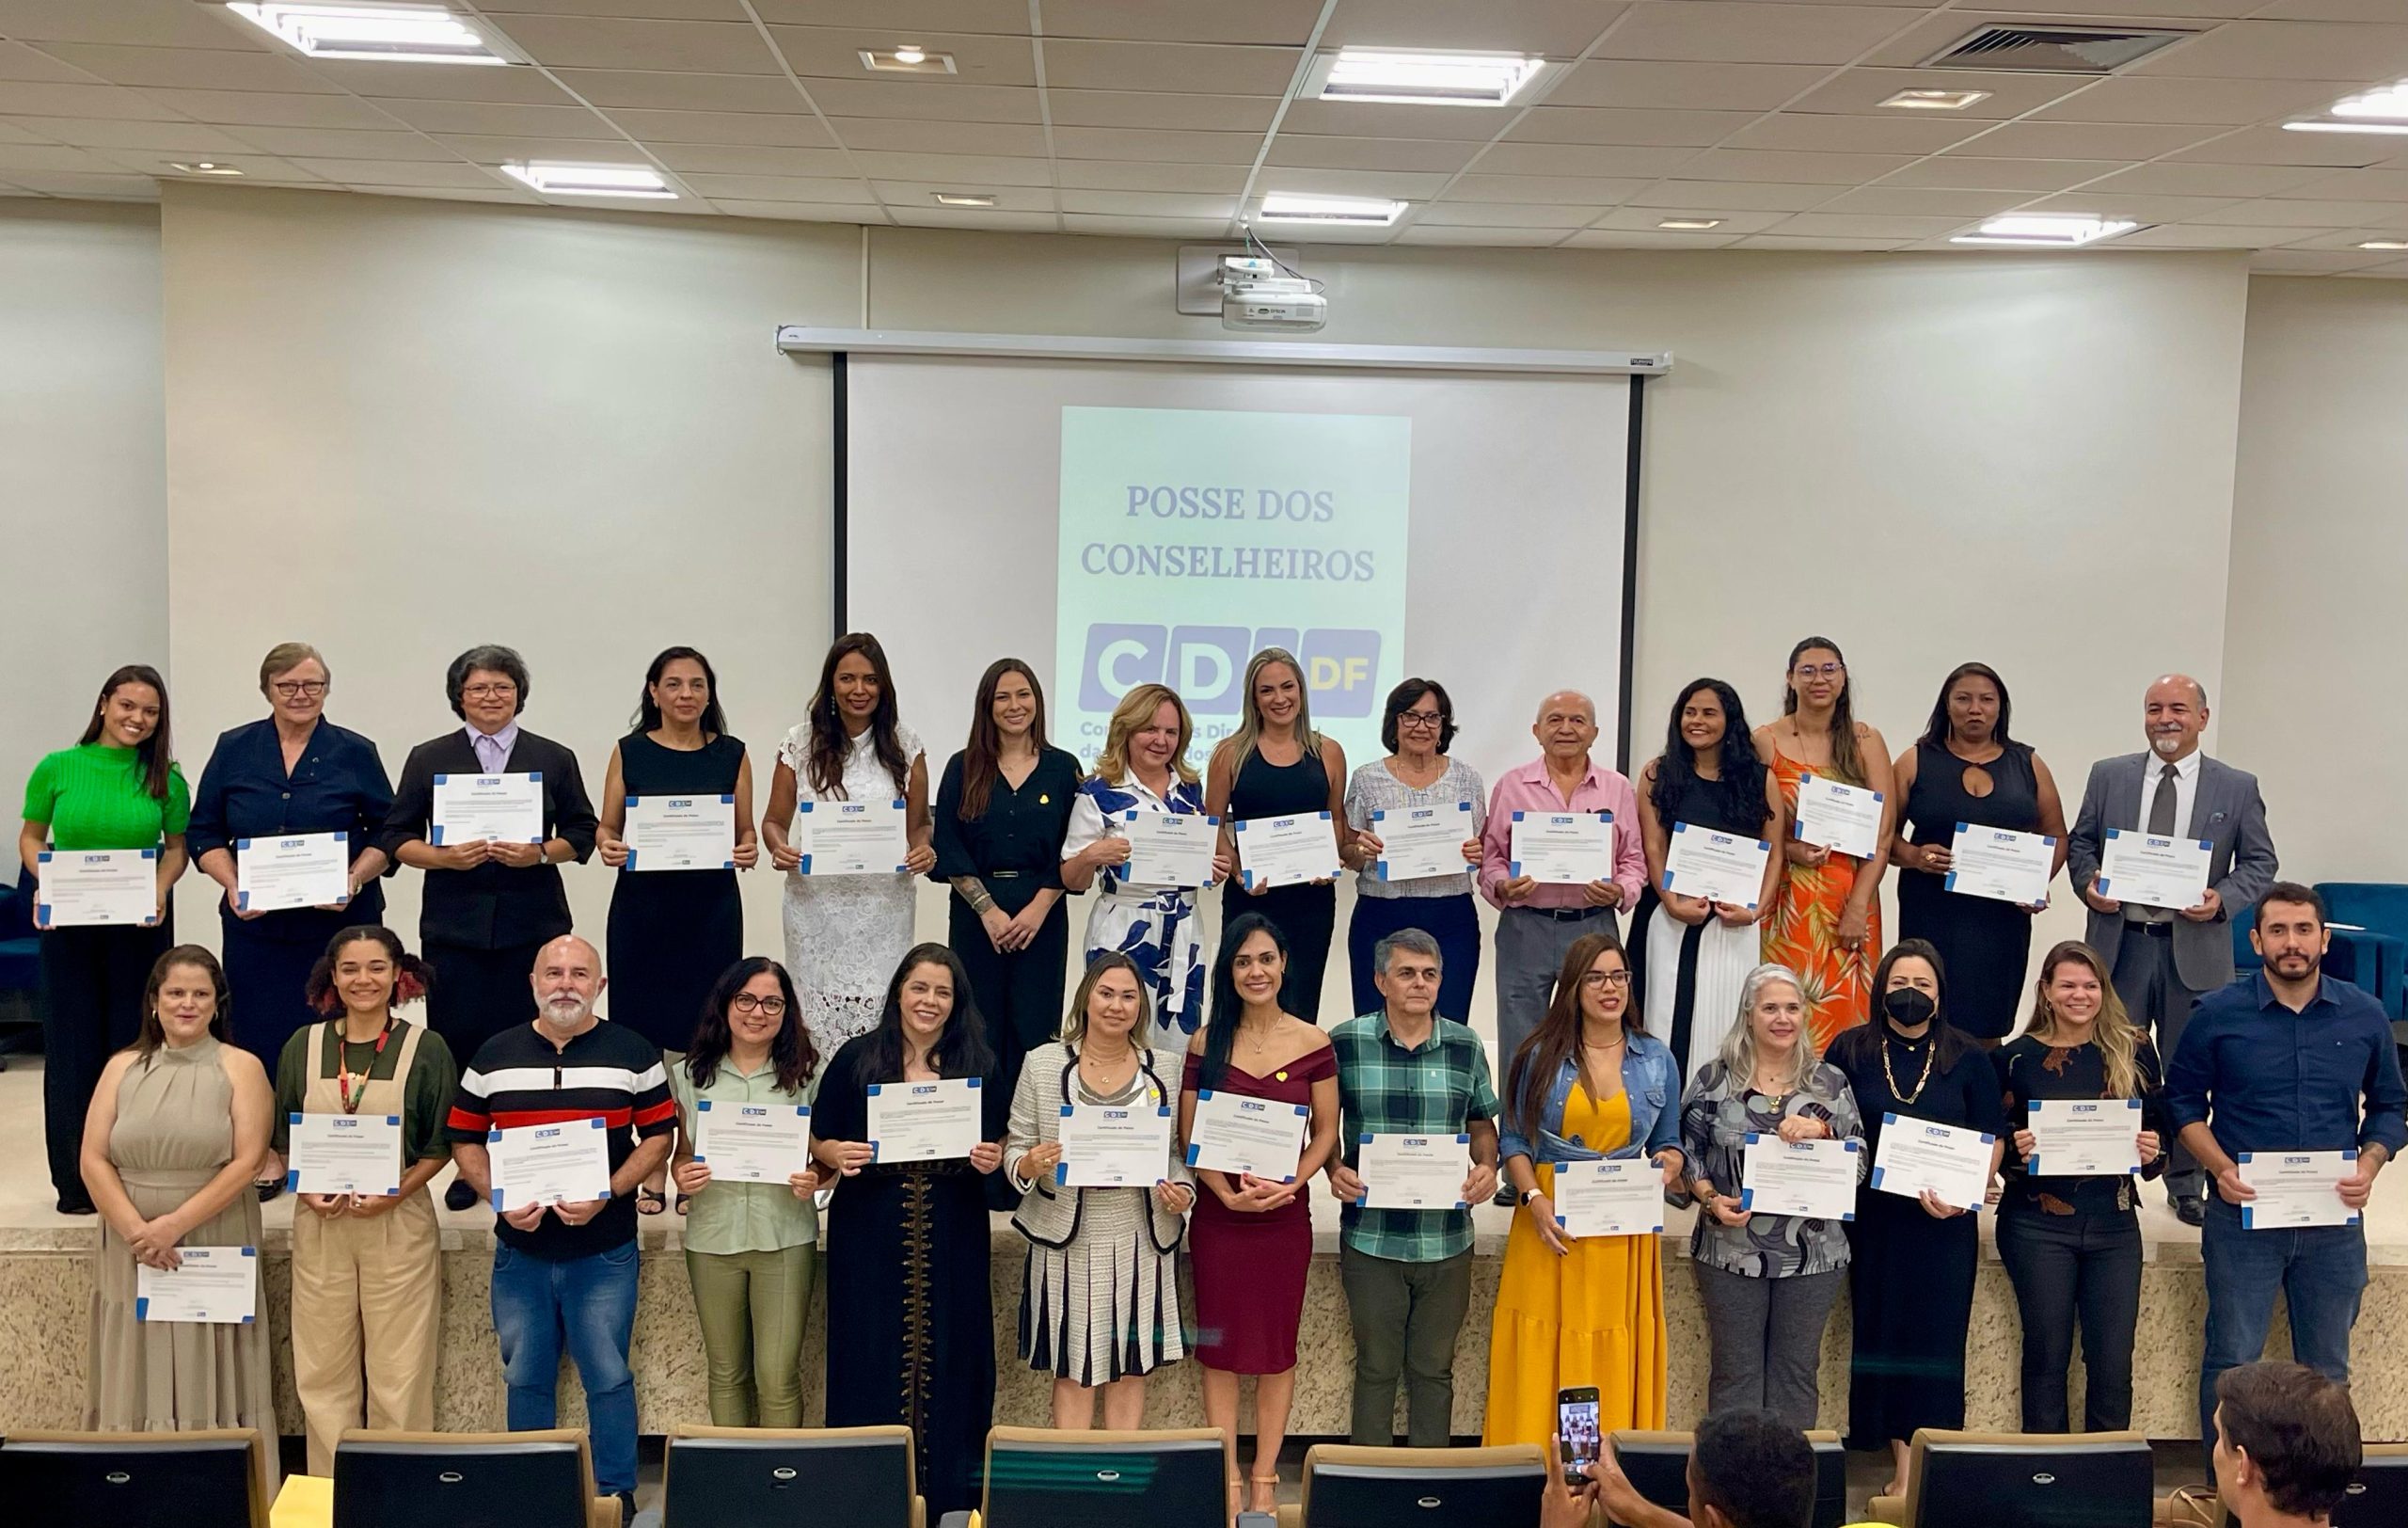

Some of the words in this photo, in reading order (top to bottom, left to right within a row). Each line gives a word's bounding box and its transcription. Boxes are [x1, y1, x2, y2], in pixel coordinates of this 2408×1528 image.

[1127, 485, 1245, 519] POSSE
[1257, 489, 1334, 522] DOS
[1082, 543, 1375, 581] CONSELHEIROS
[1310, 657, 1370, 692] DF
